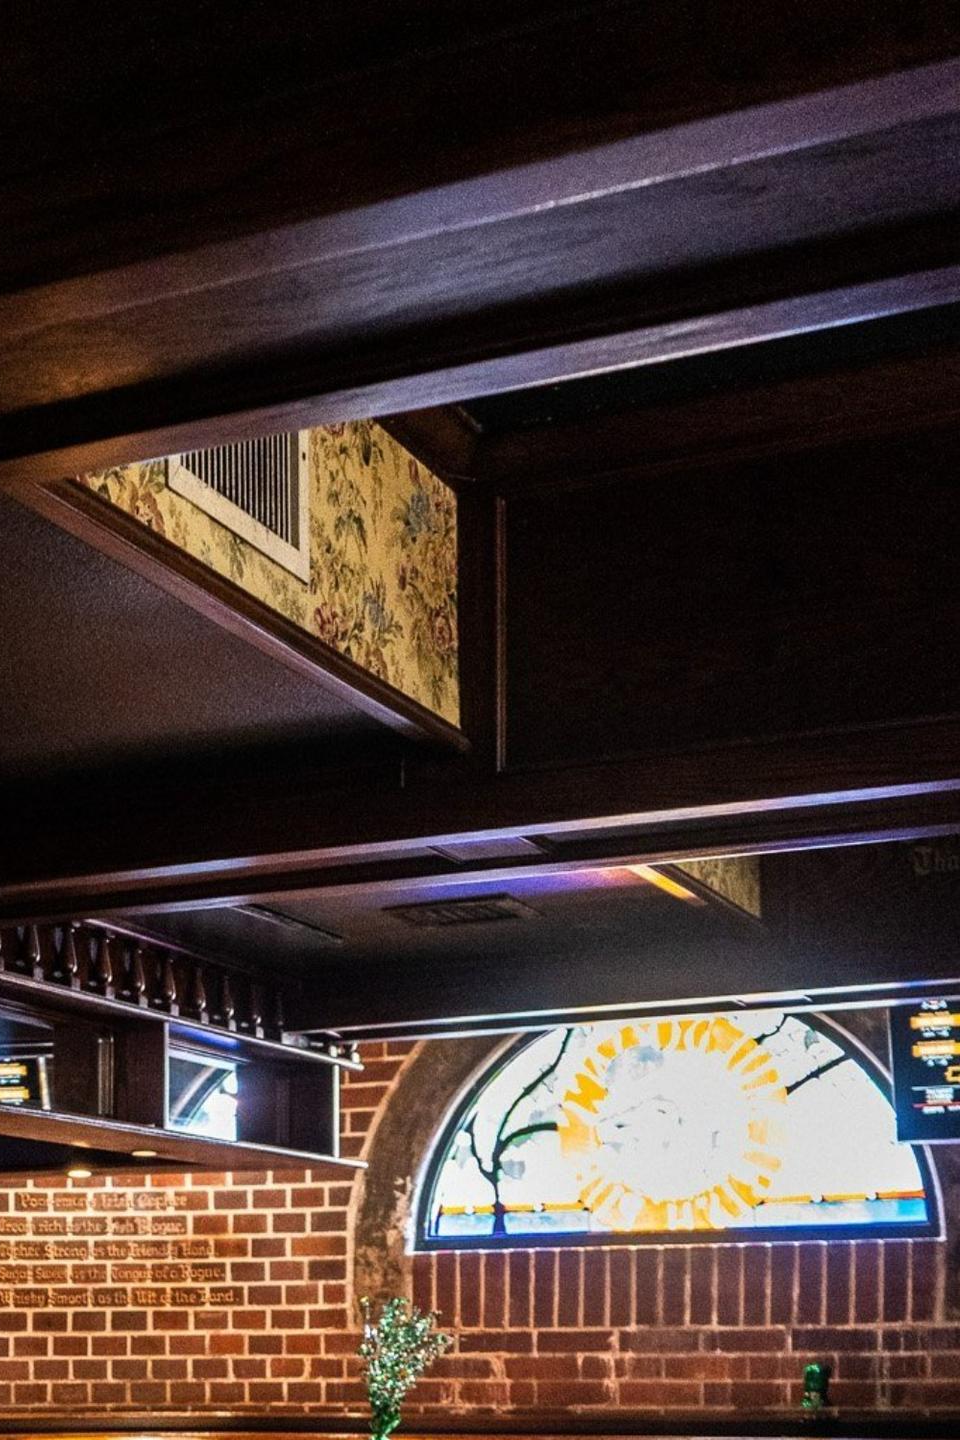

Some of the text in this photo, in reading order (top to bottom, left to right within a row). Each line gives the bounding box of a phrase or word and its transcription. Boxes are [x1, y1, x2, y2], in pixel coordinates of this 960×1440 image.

[40, 1216, 62, 1232] rich
[45, 1241, 86, 1261] Strong
[107, 1242, 126, 1257] the
[155, 1266, 169, 1279] of
[48, 1289, 95, 1306] Smooth
[98, 1294, 111, 1305] as
[114, 1290, 132, 1304] the
[175, 1289, 196, 1304] the
